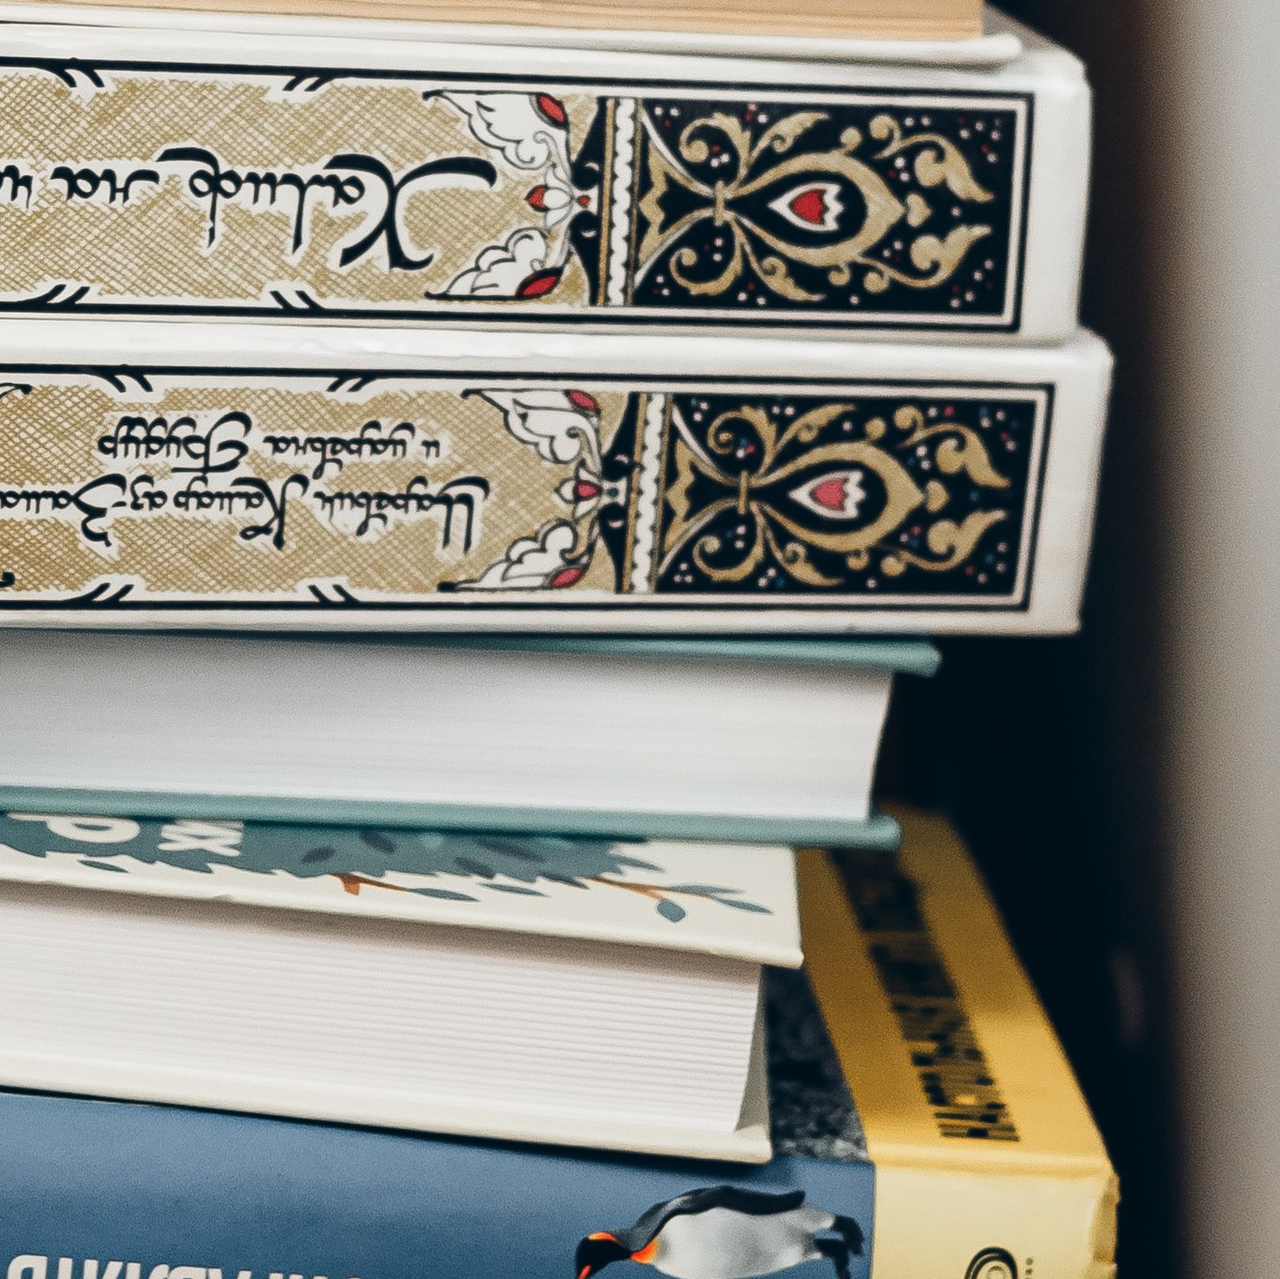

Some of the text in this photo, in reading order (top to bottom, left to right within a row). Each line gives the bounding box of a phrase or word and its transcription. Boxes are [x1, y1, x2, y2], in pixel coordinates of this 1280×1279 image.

[50, 165, 161, 206] на
[155, 146, 498, 271] Халиф
[97, 410, 441, 481] и царевна Будур
[173, 475, 310, 552] Камар
[313, 475, 491, 554] Царевич
